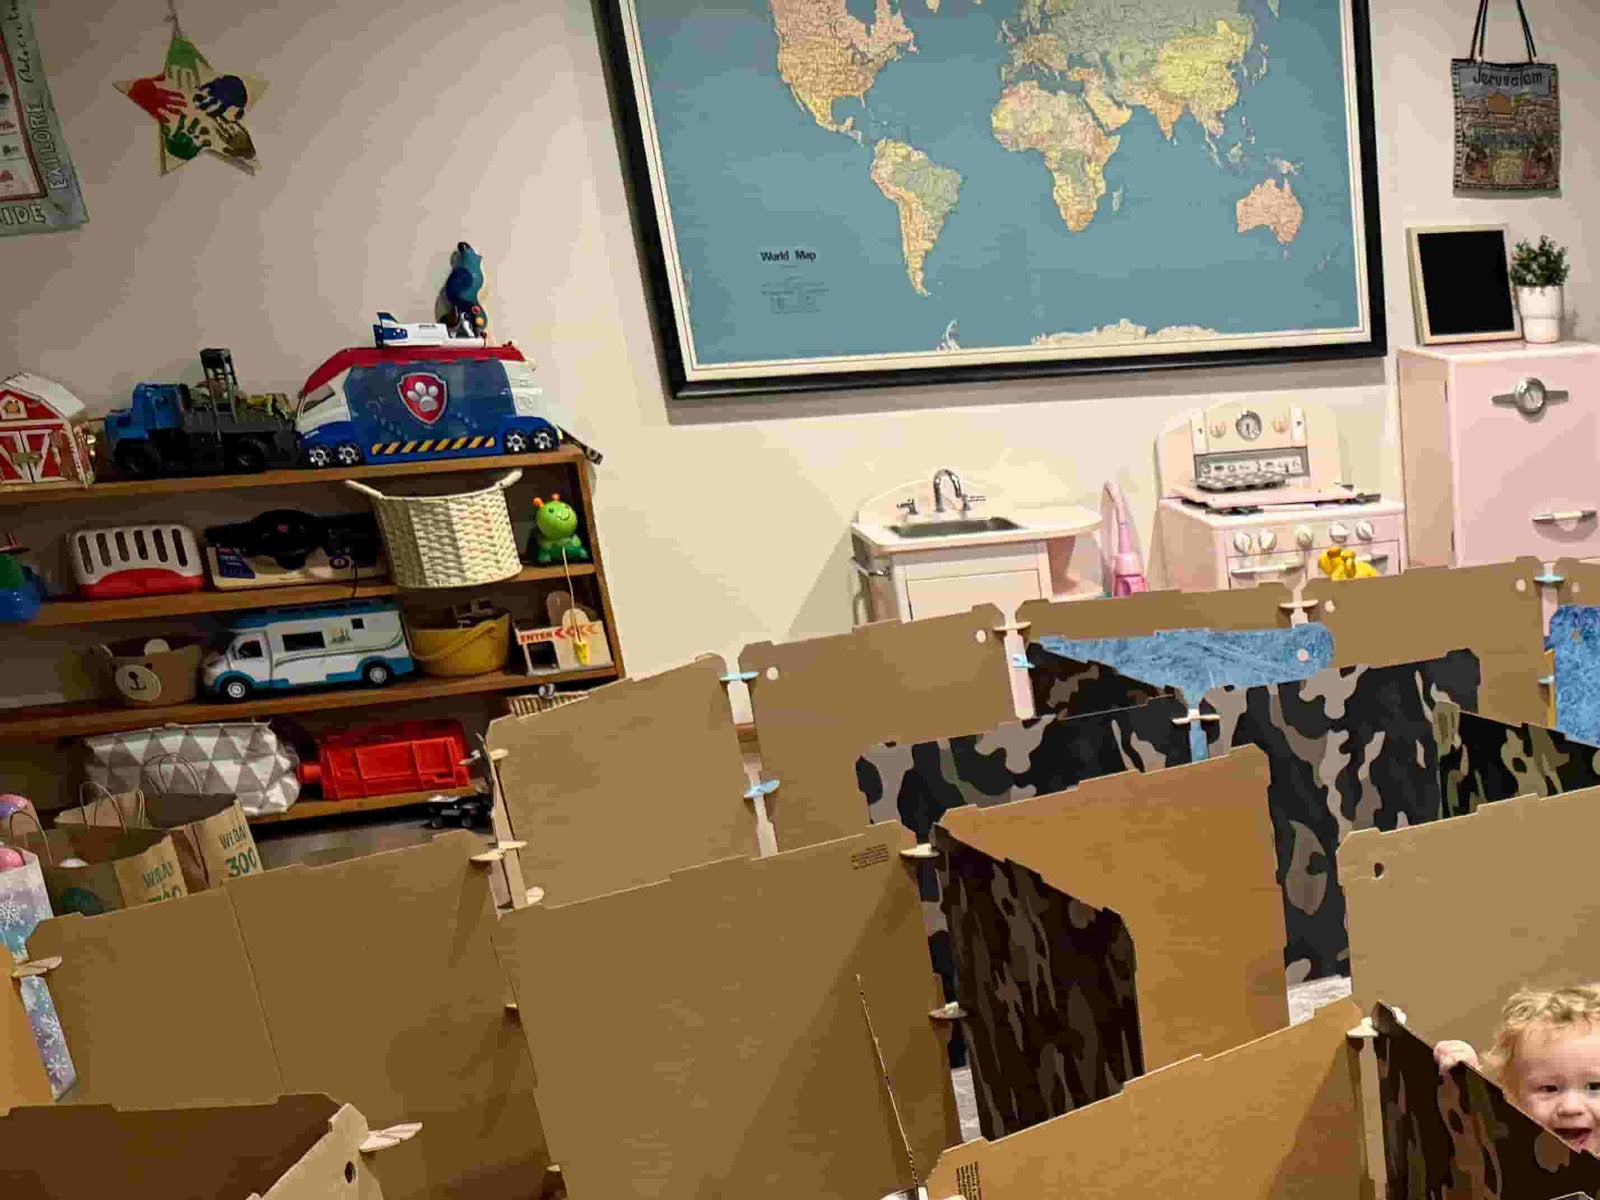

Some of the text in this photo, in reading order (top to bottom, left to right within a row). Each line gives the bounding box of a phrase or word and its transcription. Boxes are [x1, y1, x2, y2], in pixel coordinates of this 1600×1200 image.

[1473, 71, 1543, 87] Jerusalem
[27, 101, 69, 190] EXPLORE
[0, 204, 47, 225] IDE
[760, 250, 817, 263] World Map
[225, 846, 258, 878] 300
